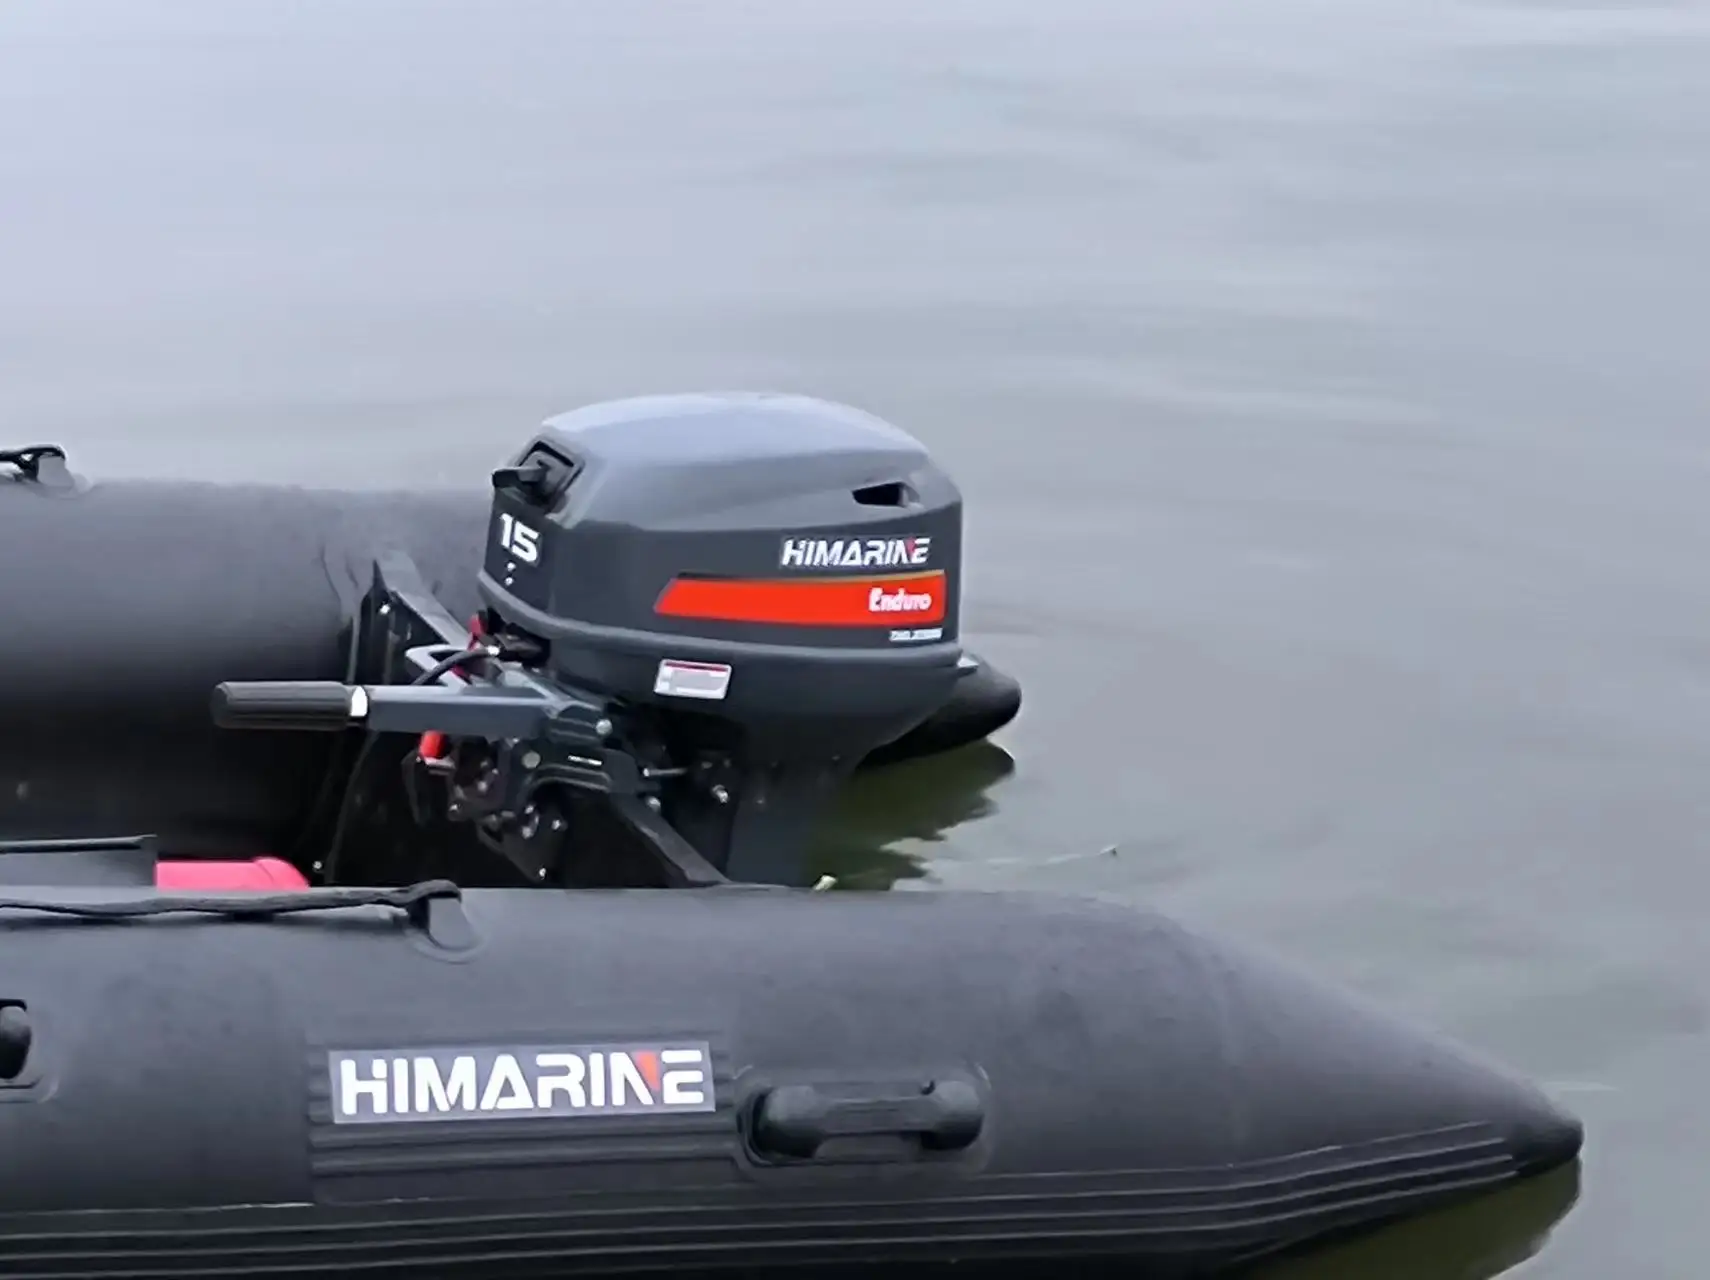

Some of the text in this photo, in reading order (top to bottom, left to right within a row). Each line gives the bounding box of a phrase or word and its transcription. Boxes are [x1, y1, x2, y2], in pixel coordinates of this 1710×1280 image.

[501, 513, 539, 562] 15
[782, 537, 931, 566] HIMARINE
[868, 587, 932, 612] Enduro
[340, 1049, 704, 1115] HIMARINE
